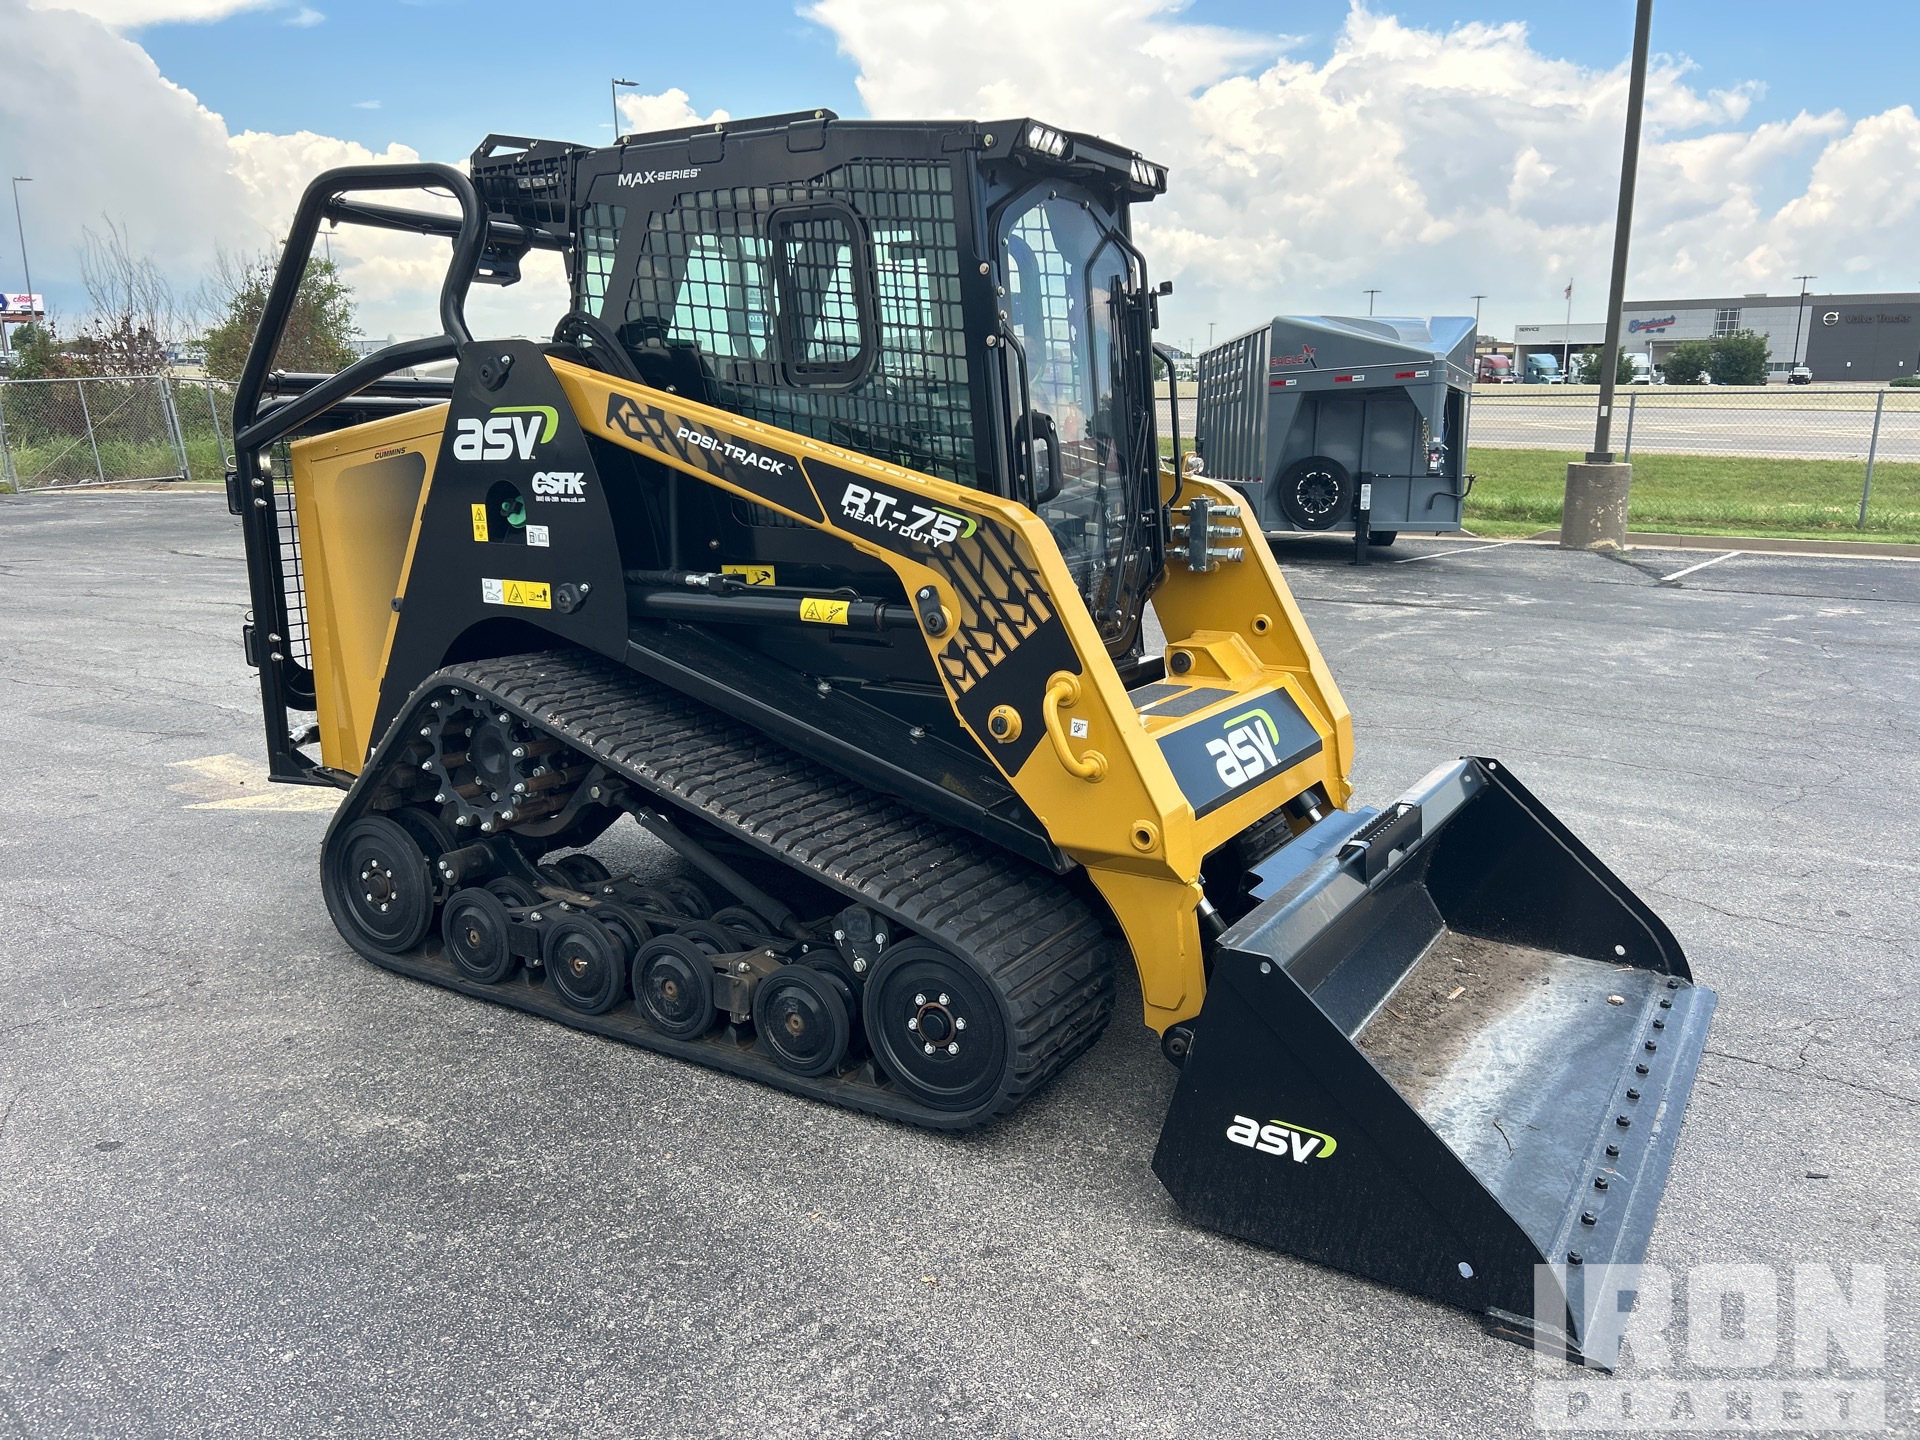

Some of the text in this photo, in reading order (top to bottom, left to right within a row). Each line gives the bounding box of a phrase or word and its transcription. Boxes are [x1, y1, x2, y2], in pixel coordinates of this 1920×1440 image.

[618, 168, 701, 188] MAX-SERIES
[1845, 313, 1912, 324] Volvo Trucks
[374, 446, 407, 460] CUMMINS
[676, 426, 786, 476] POSI-TRACK
[840, 483, 962, 542] RT-75
[842, 506, 944, 548] HEAVY DUTY
